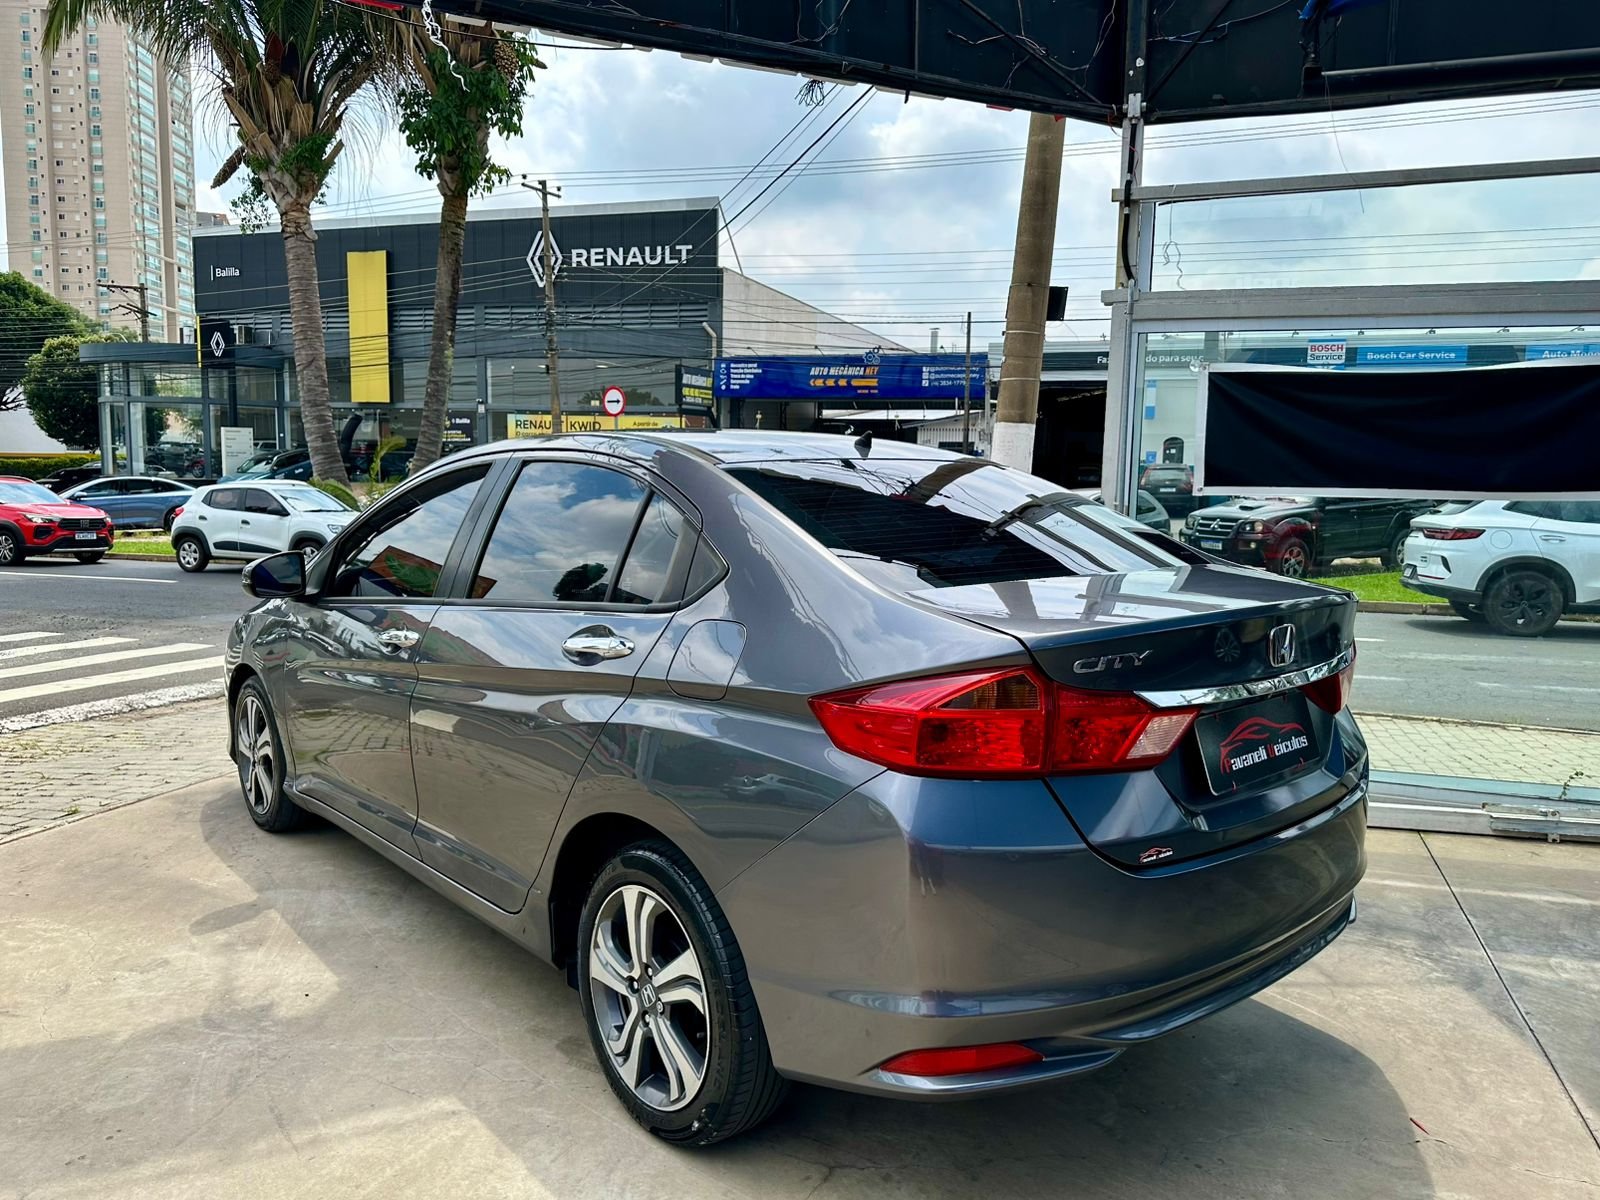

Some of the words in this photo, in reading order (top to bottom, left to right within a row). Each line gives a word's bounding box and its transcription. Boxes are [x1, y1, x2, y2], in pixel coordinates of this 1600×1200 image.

[570, 244, 693, 268] RENAULT
[215, 266, 240, 277] Balilla
[1309, 344, 1344, 353] BOSCH
[1096, 355, 1109, 364] Fa
[1159, 355, 1180, 364] para
[1308, 353, 1344, 362] Service
[1367, 352, 1397, 361] Bosch
[1398, 351, 1416, 360] Car
[1417, 351, 1456, 360] Service
[1542, 350, 1568, 359] Auto
[810, 366, 829, 376] AUTO
[829, 364, 865, 376] MECÂNICA
[515, 419, 564, 430] RENAU
[569, 421, 602, 431] KWID
[1073, 649, 1153, 674] CITY
[1224, 746, 1267, 774] Pavaneli
[1266, 735, 1308, 759] Veículos
